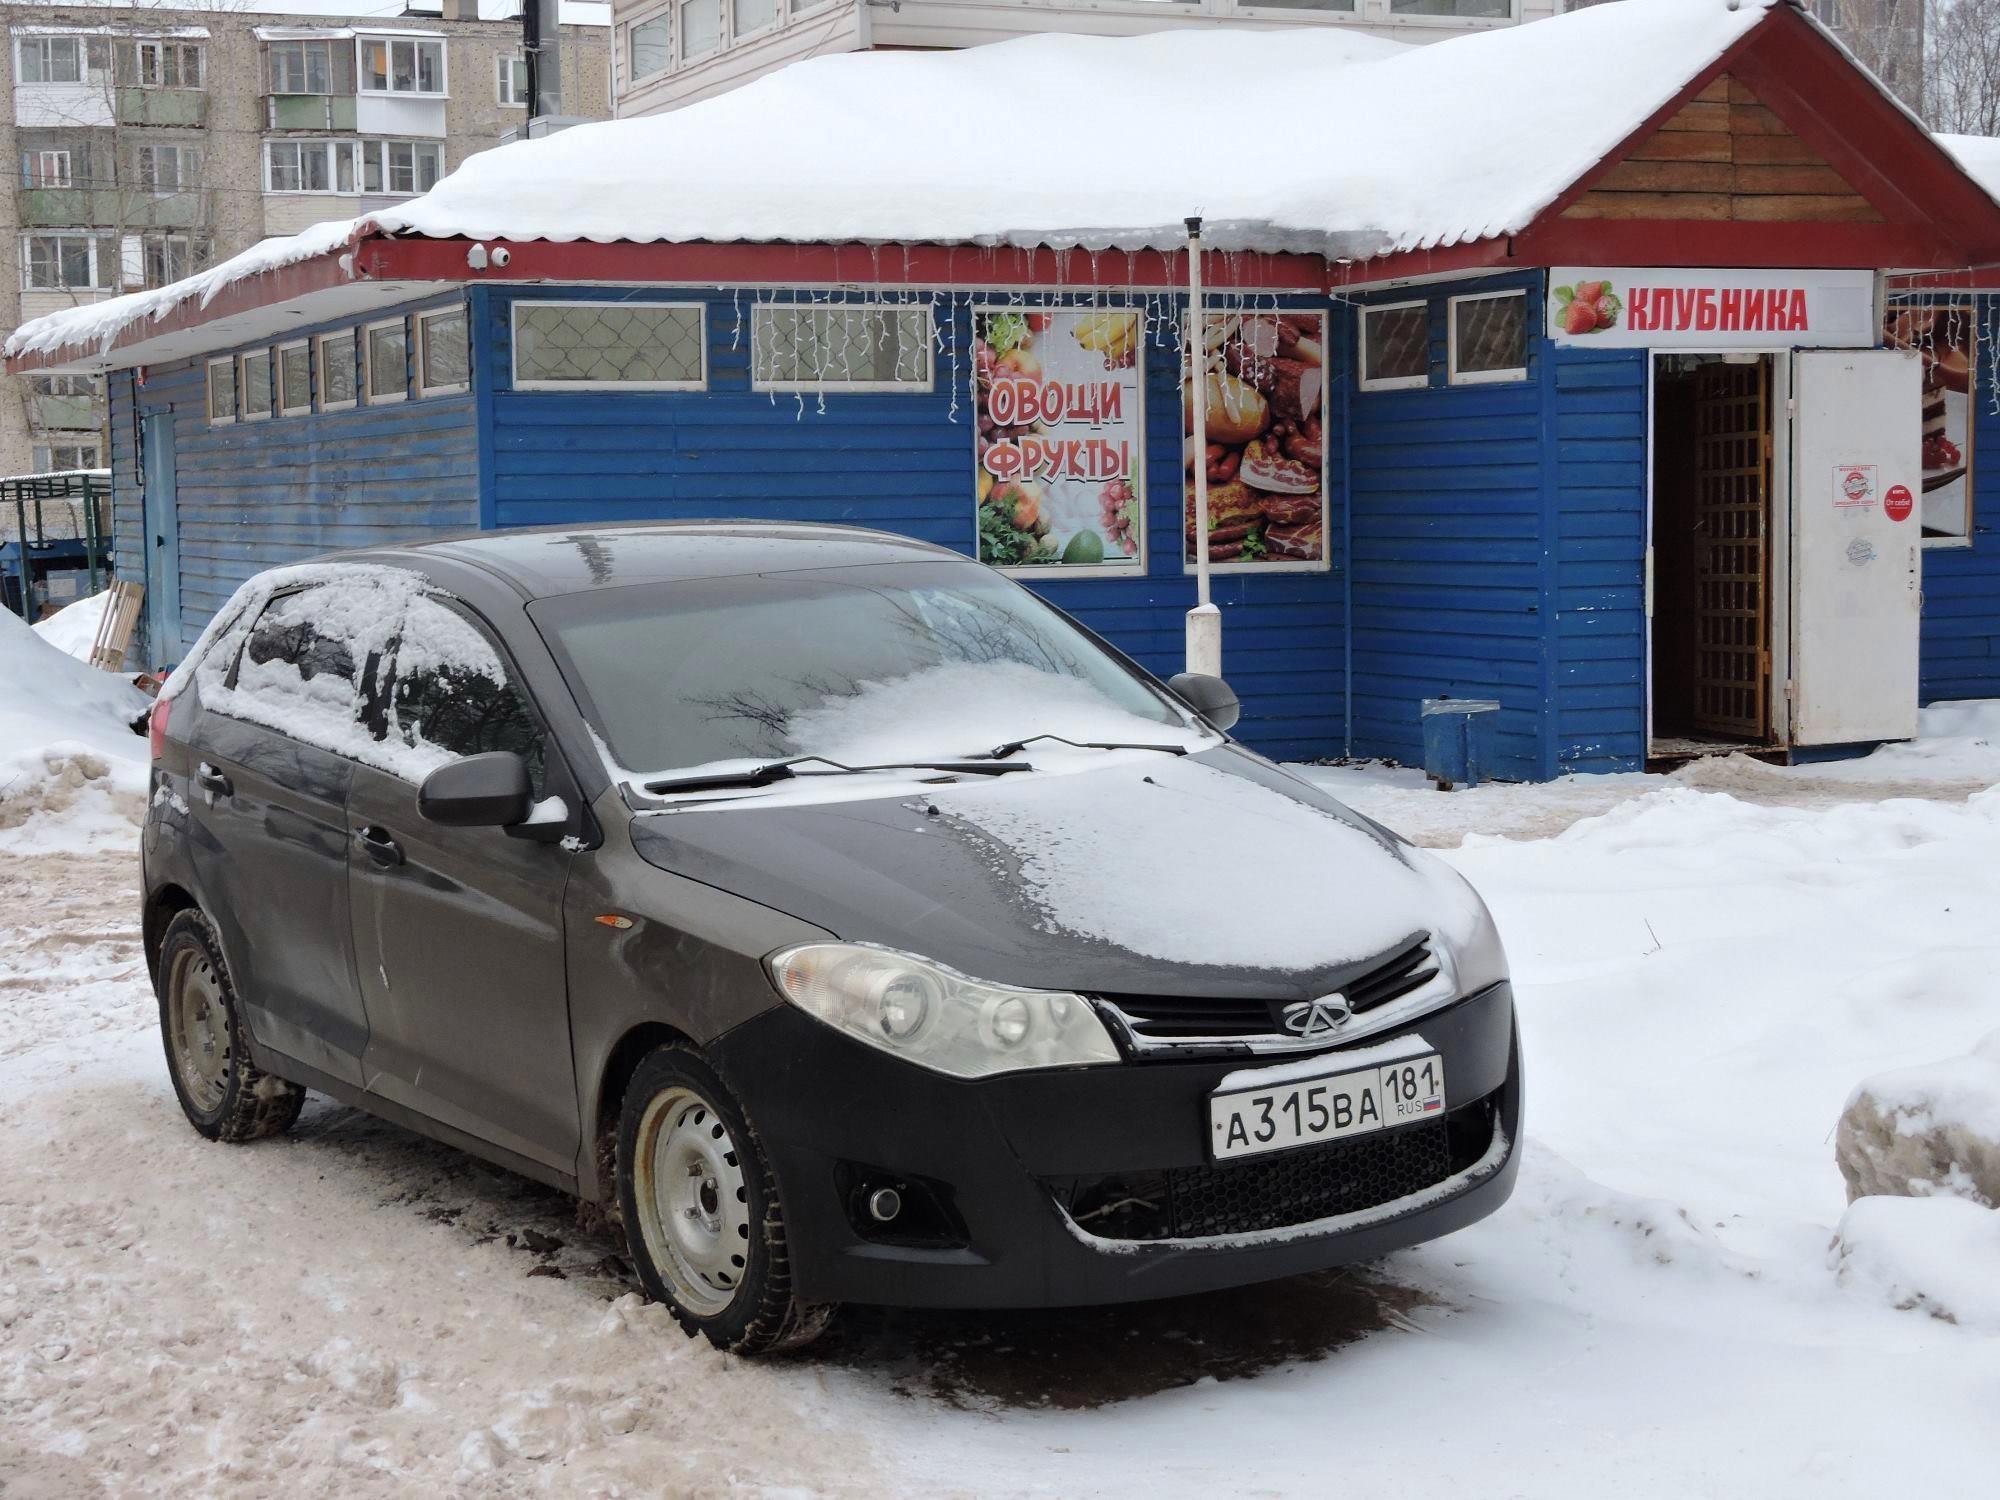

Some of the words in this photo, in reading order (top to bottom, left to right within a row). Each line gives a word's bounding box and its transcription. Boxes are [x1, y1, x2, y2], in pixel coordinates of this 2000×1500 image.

[1627, 287, 1809, 331] КЛУБНИКА
[990, 379, 1123, 427] ОВОЩИ
[985, 437, 1130, 481] ФРУКТЫ
[1226, 1086, 1379, 1149] А315ВА
[1385, 1062, 1434, 1103] 181
[1396, 1100, 1422, 1117] RUS
